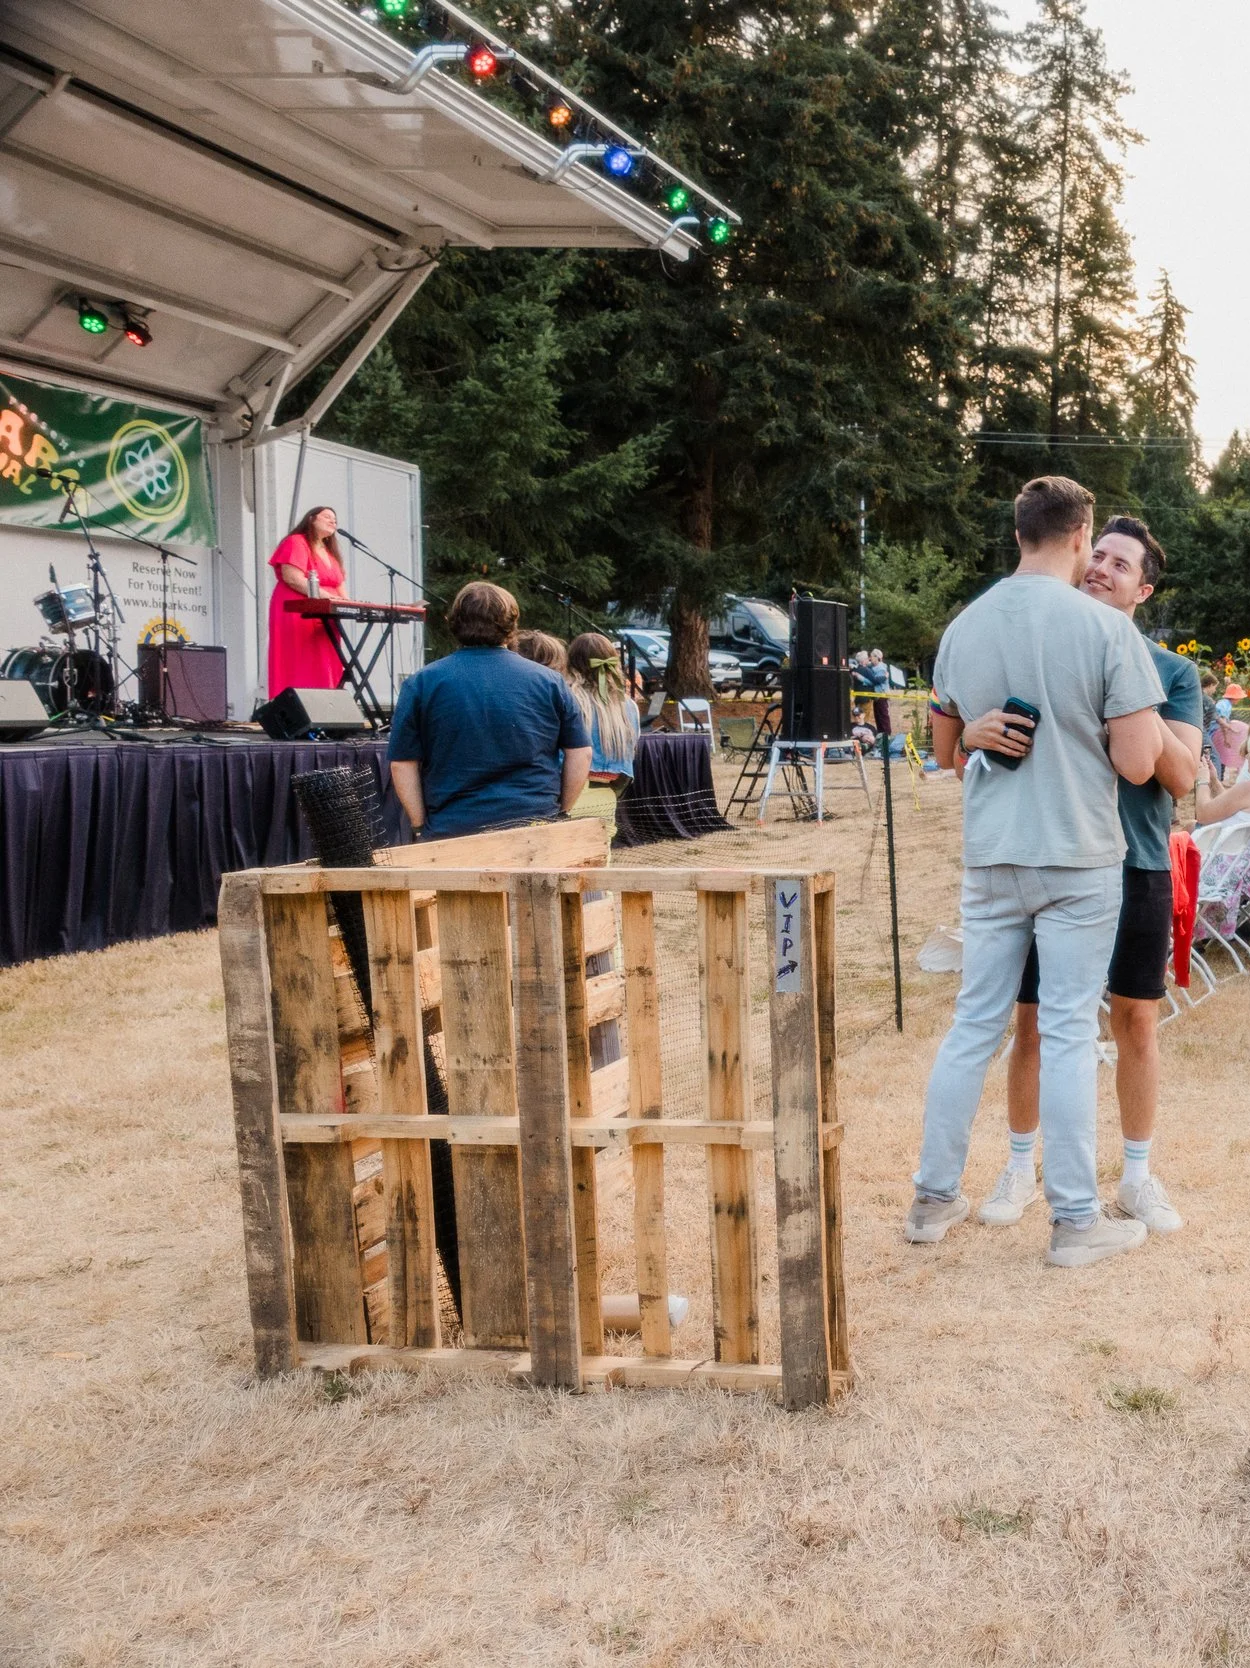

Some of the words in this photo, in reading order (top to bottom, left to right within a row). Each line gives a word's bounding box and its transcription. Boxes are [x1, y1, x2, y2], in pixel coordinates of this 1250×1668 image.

[132, 562, 171, 577] Reserve
[174, 567, 197, 579] Now
[128, 578, 144, 591] For
[147, 580, 169, 593] Your
[172, 583, 202, 597] Event!
[779, 891, 798, 957] VIP
